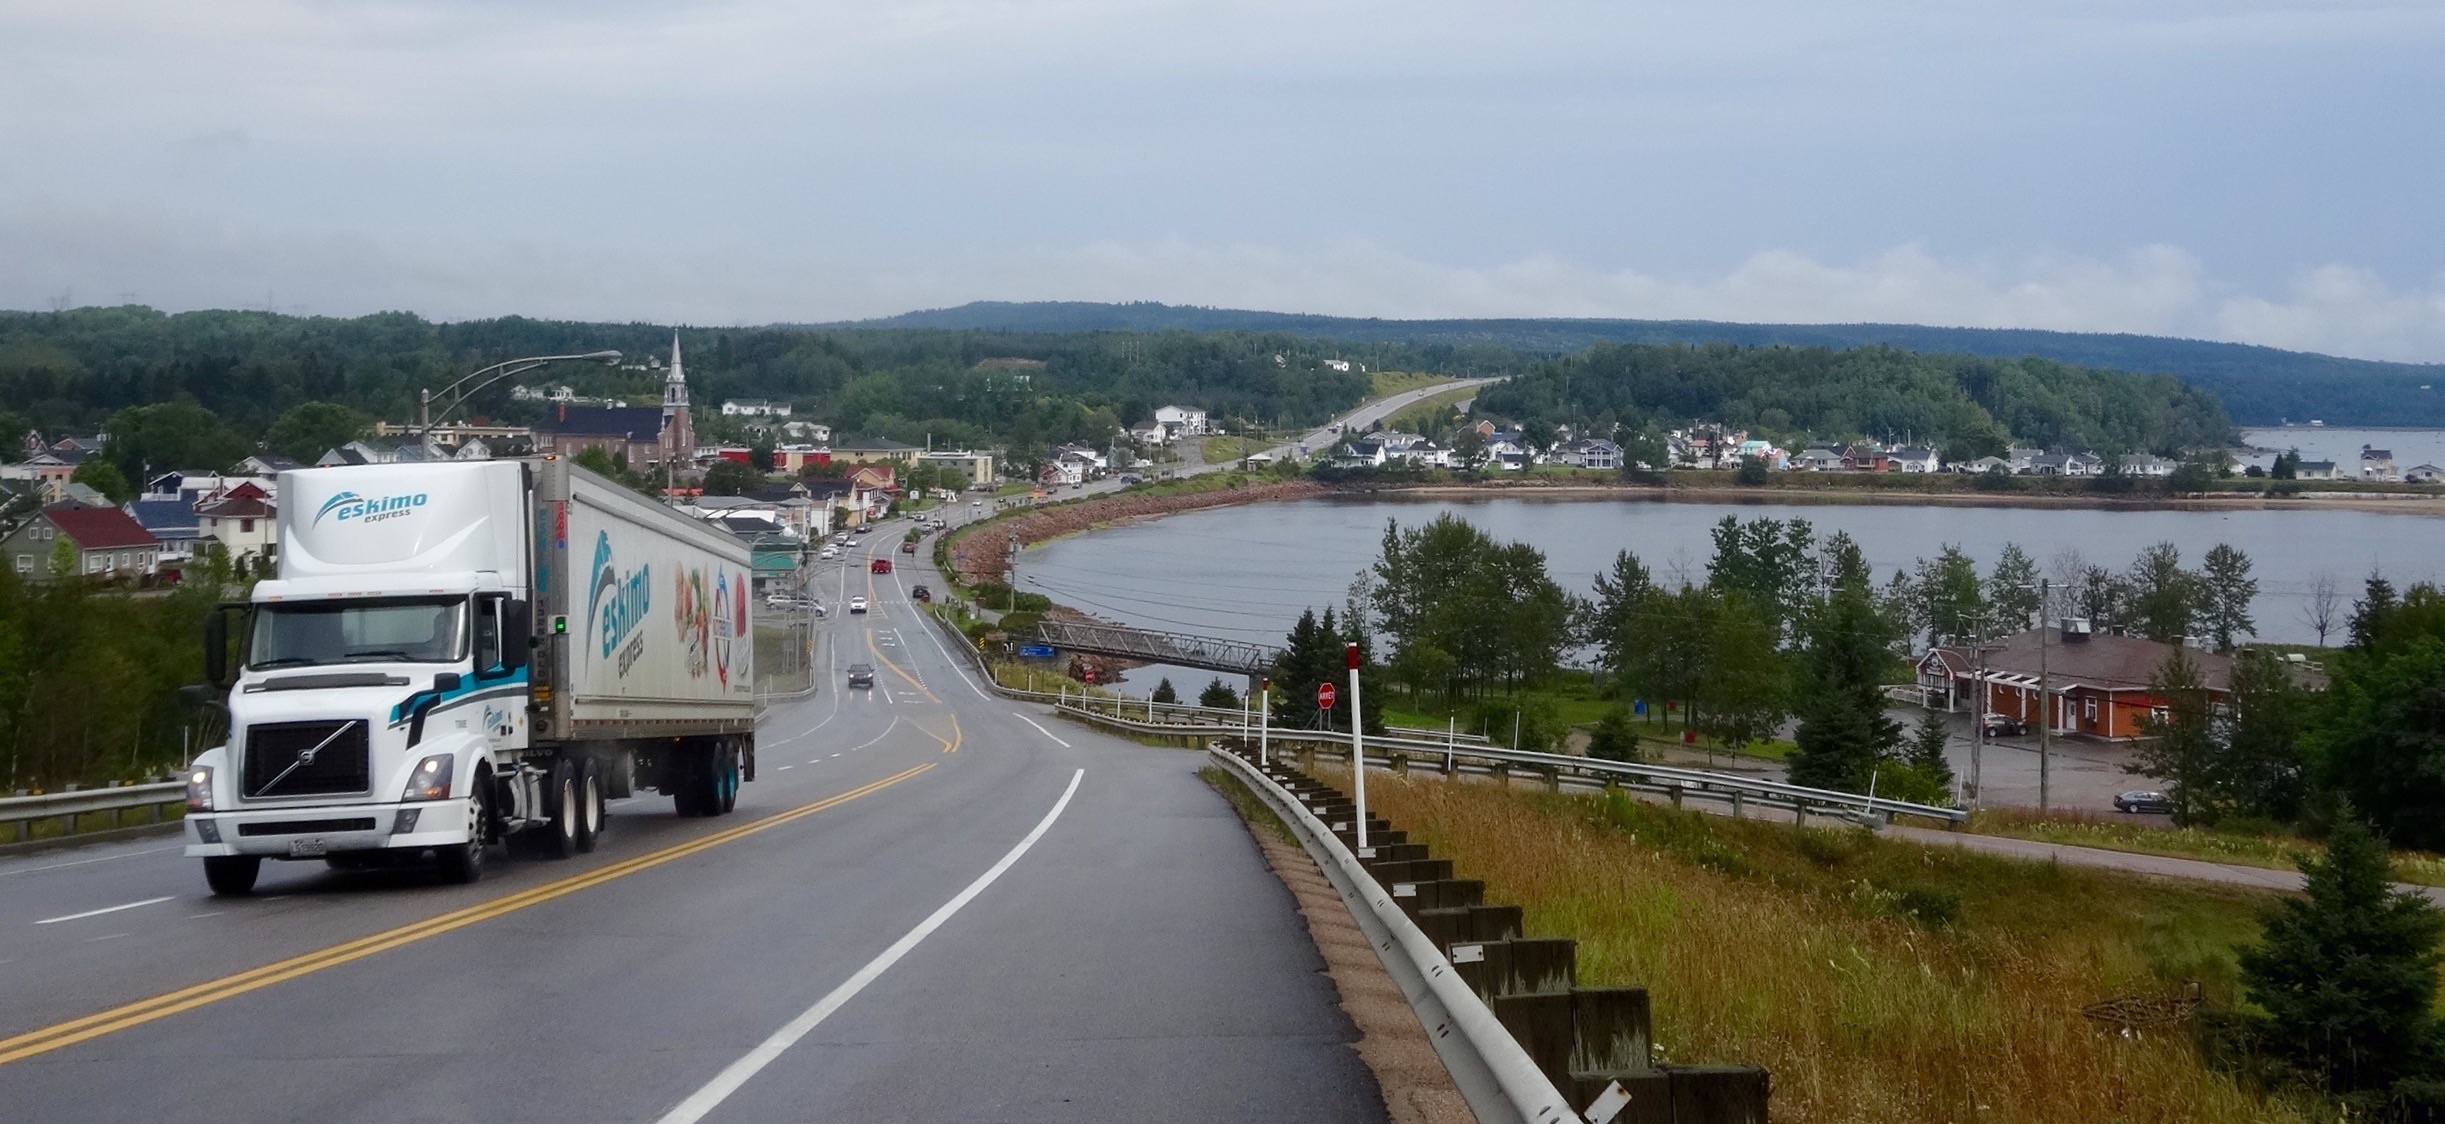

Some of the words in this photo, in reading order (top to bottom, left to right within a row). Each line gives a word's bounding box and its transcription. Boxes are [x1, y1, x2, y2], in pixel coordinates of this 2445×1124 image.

[337, 493, 428, 521] eskimo
[364, 508, 411, 523] express
[602, 562, 650, 660] eskimo
[618, 630, 644, 679] express
[1319, 691, 1335, 700] ARRÊT
